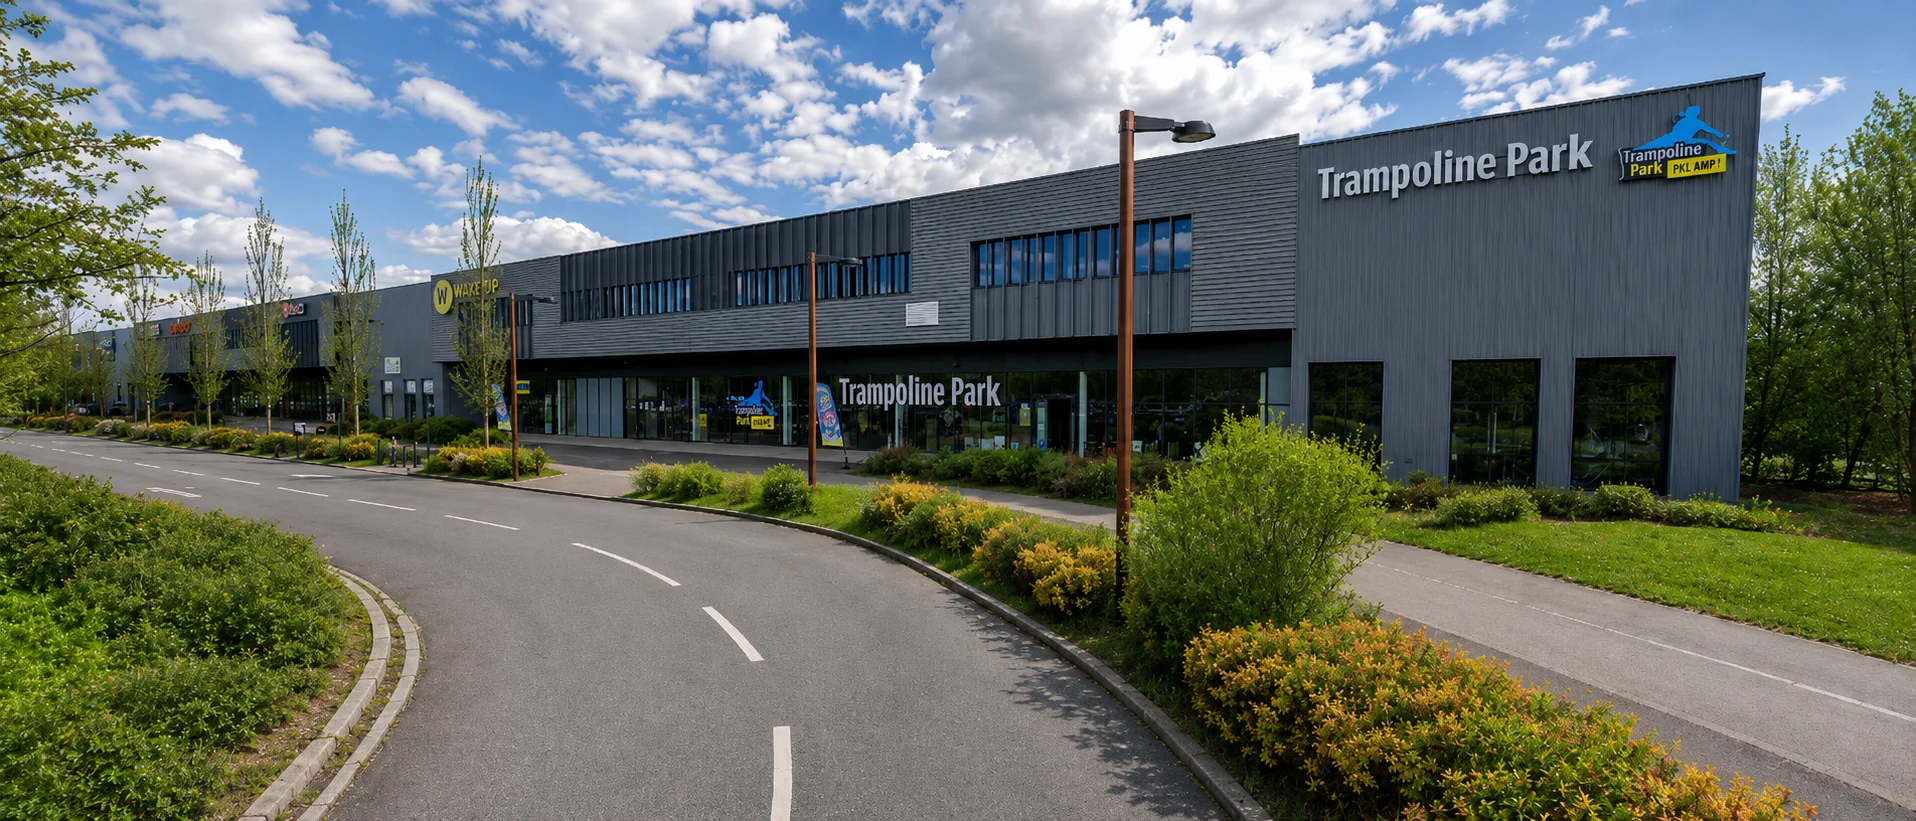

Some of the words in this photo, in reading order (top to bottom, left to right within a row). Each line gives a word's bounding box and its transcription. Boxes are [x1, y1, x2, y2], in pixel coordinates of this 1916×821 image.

[1623, 143, 1702, 163] Trampoline
[1317, 149, 1497, 199] Trampoline
[1507, 133, 1594, 177] Park
[1630, 161, 1663, 177] Park
[453, 281, 481, 298] WAKE
[484, 278, 499, 294] UP
[838, 375, 945, 411] Trampoline
[951, 375, 1001, 407] Park
